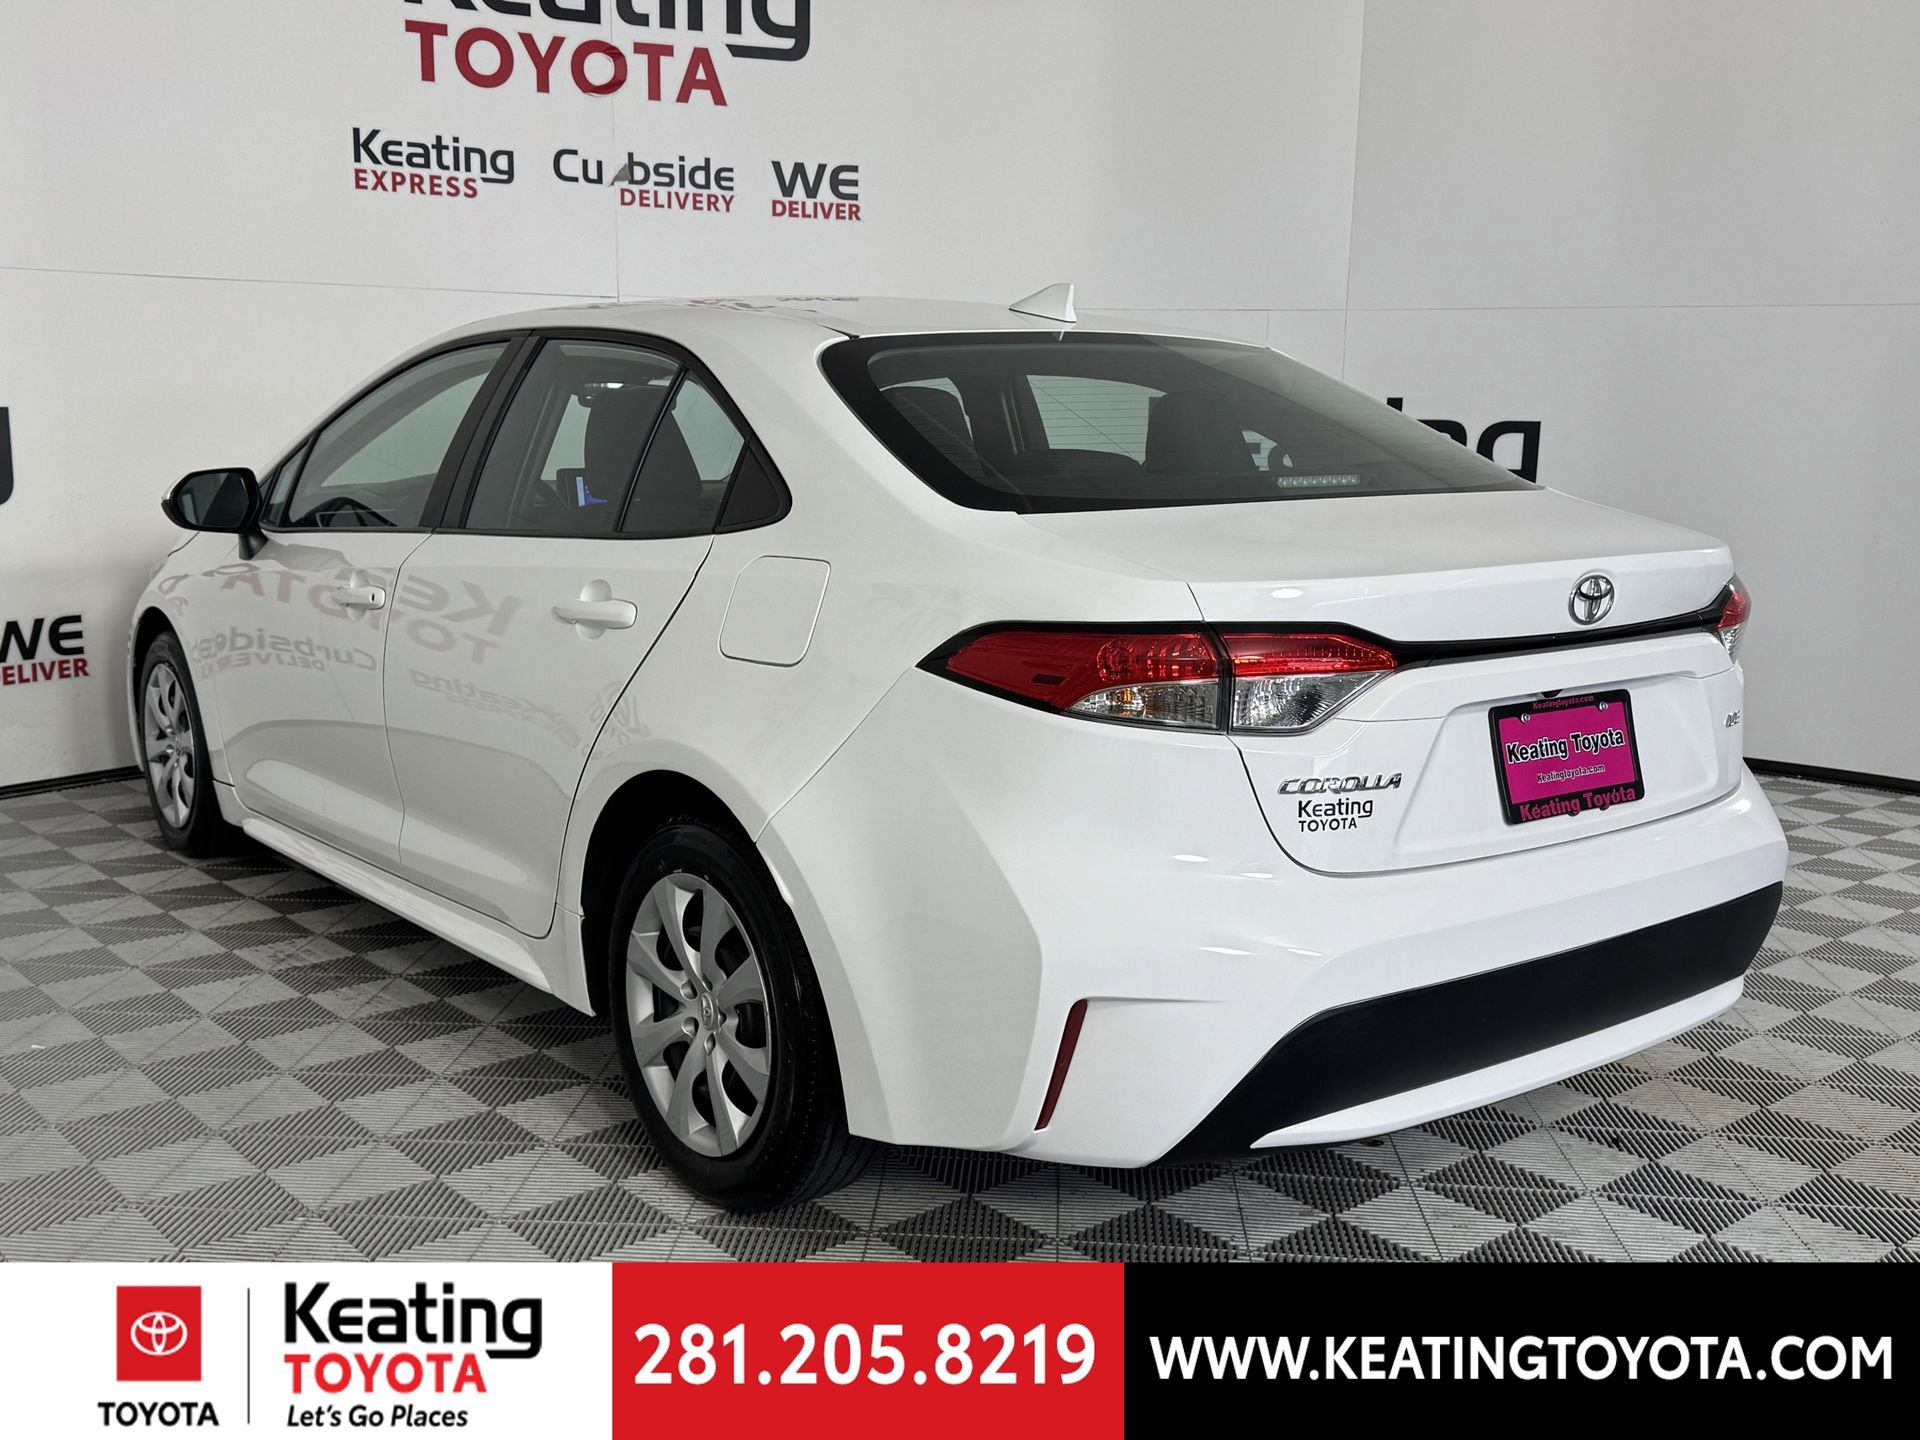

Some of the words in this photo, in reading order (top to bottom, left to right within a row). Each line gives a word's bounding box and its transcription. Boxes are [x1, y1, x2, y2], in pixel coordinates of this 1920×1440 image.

[404, 19, 728, 107] TOYOTA
[352, 127, 515, 184] Keating
[354, 168, 478, 199] EXPRESS
[552, 149, 735, 192] Cubside
[771, 161, 860, 200] WE
[620, 188, 735, 213] DELIVERY
[771, 200, 861, 220] DELIVER
[0, 658, 89, 686] ELIVER
[1507, 738, 1568, 763] Keating
[1570, 728, 1625, 754] Toyota
[1277, 772, 1403, 795] COROLLA
[1537, 765, 1605, 784] Keatingtoyota.com
[1298, 797, 1374, 819] Keating
[1519, 798, 1581, 821] Keating
[1583, 786, 1636, 811] Toyota
[1298, 817, 1358, 833] TOYOTA
